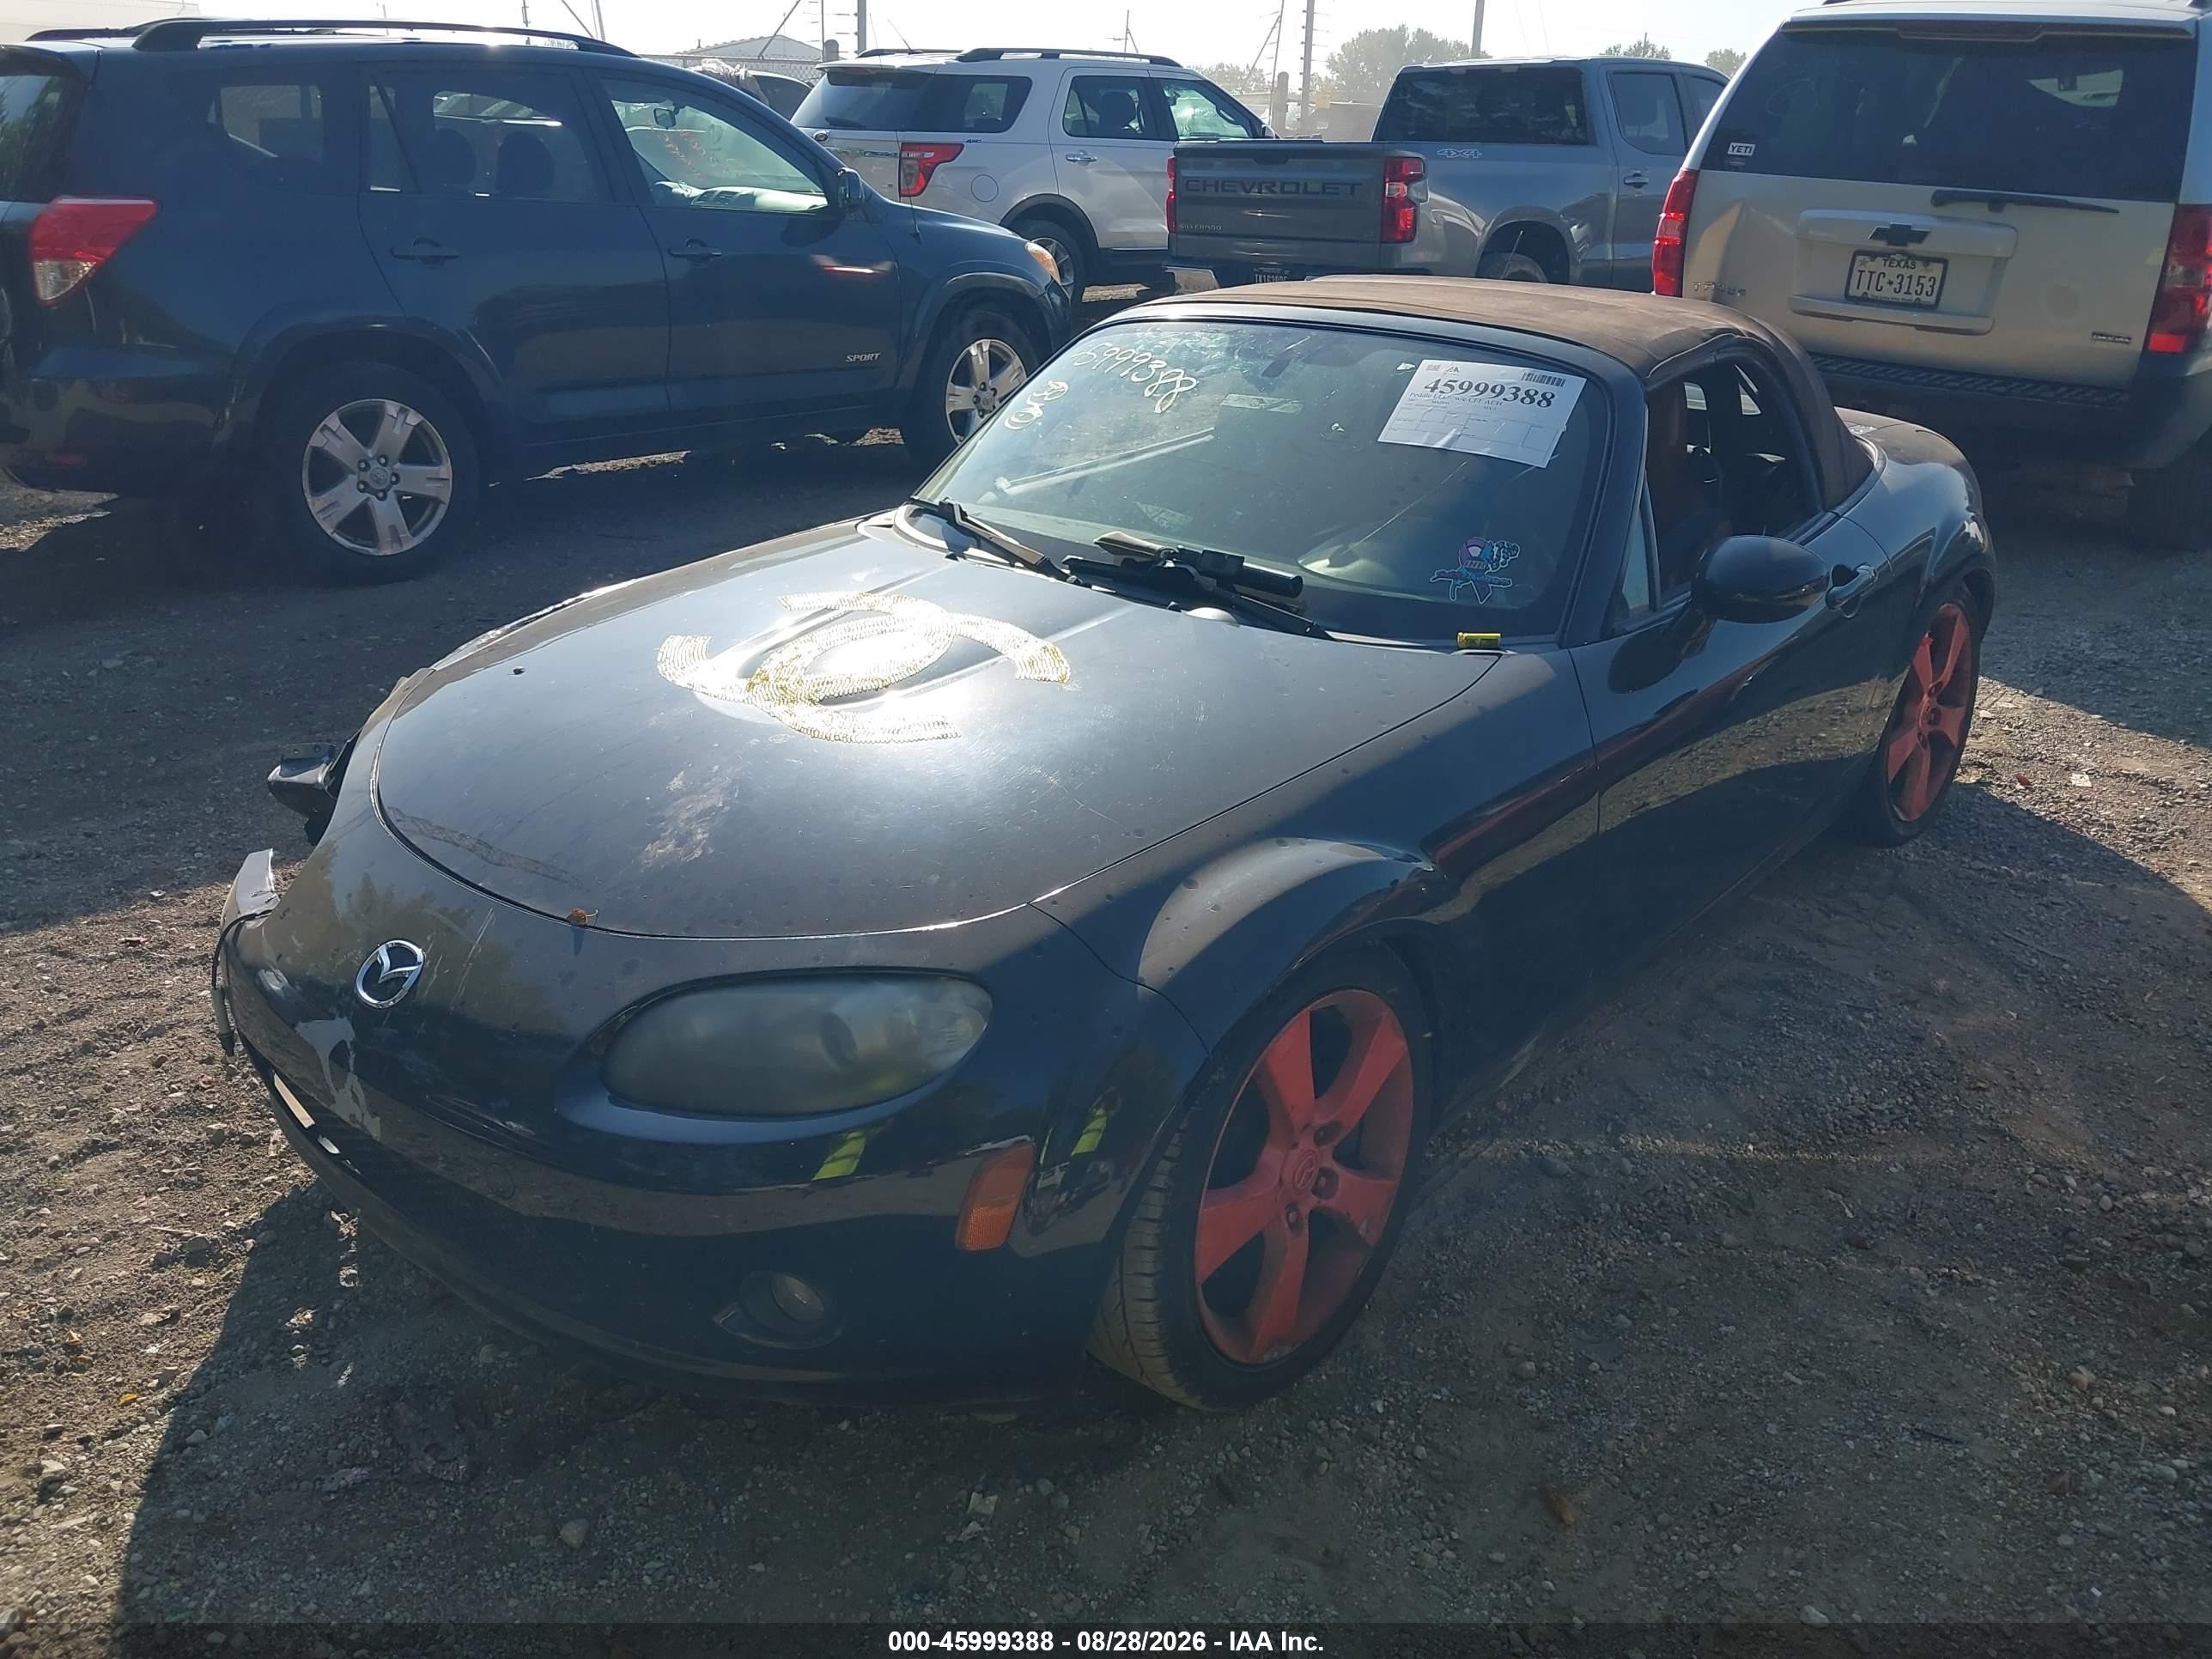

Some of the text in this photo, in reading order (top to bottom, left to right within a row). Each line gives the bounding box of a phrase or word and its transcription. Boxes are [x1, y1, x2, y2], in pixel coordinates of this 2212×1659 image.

[1729, 144, 1753, 154] YETI
[1184, 179, 1363, 196] CHEVROLET
[1882, 258, 1917, 270] TEXAS
[845, 352, 881, 362] SPORT
[1424, 378, 1556, 409] 45999388
